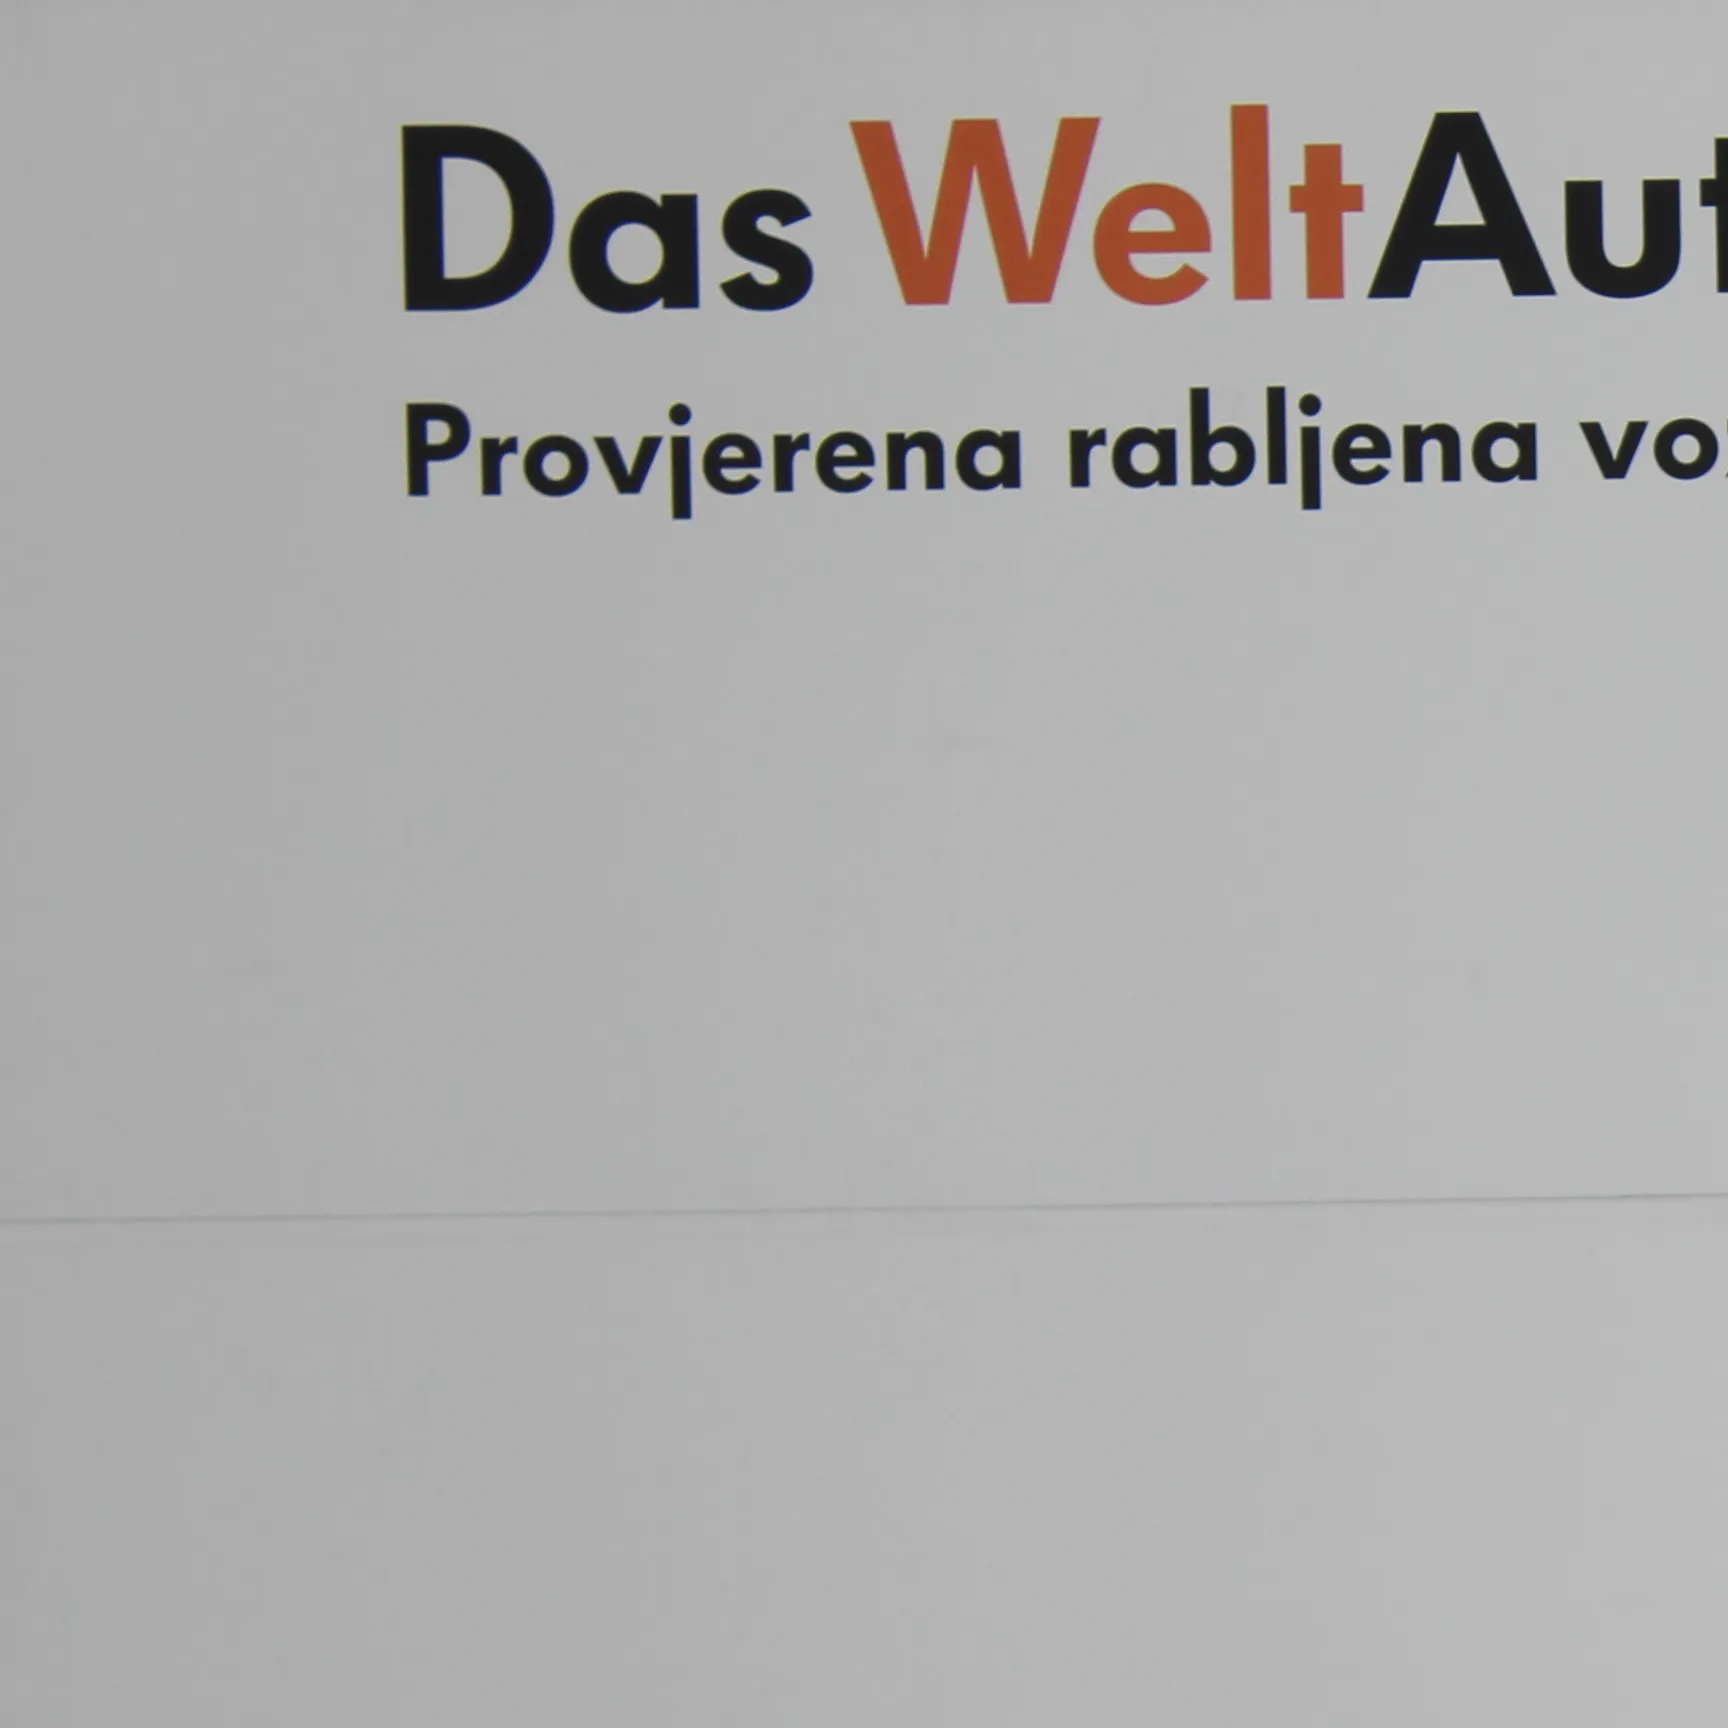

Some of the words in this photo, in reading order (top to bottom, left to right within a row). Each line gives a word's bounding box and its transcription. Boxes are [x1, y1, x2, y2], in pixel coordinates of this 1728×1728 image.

[401, 124, 814, 314] Das
[404, 402, 1023, 521] Provjerena
[1069, 385, 1539, 512] rabljena
